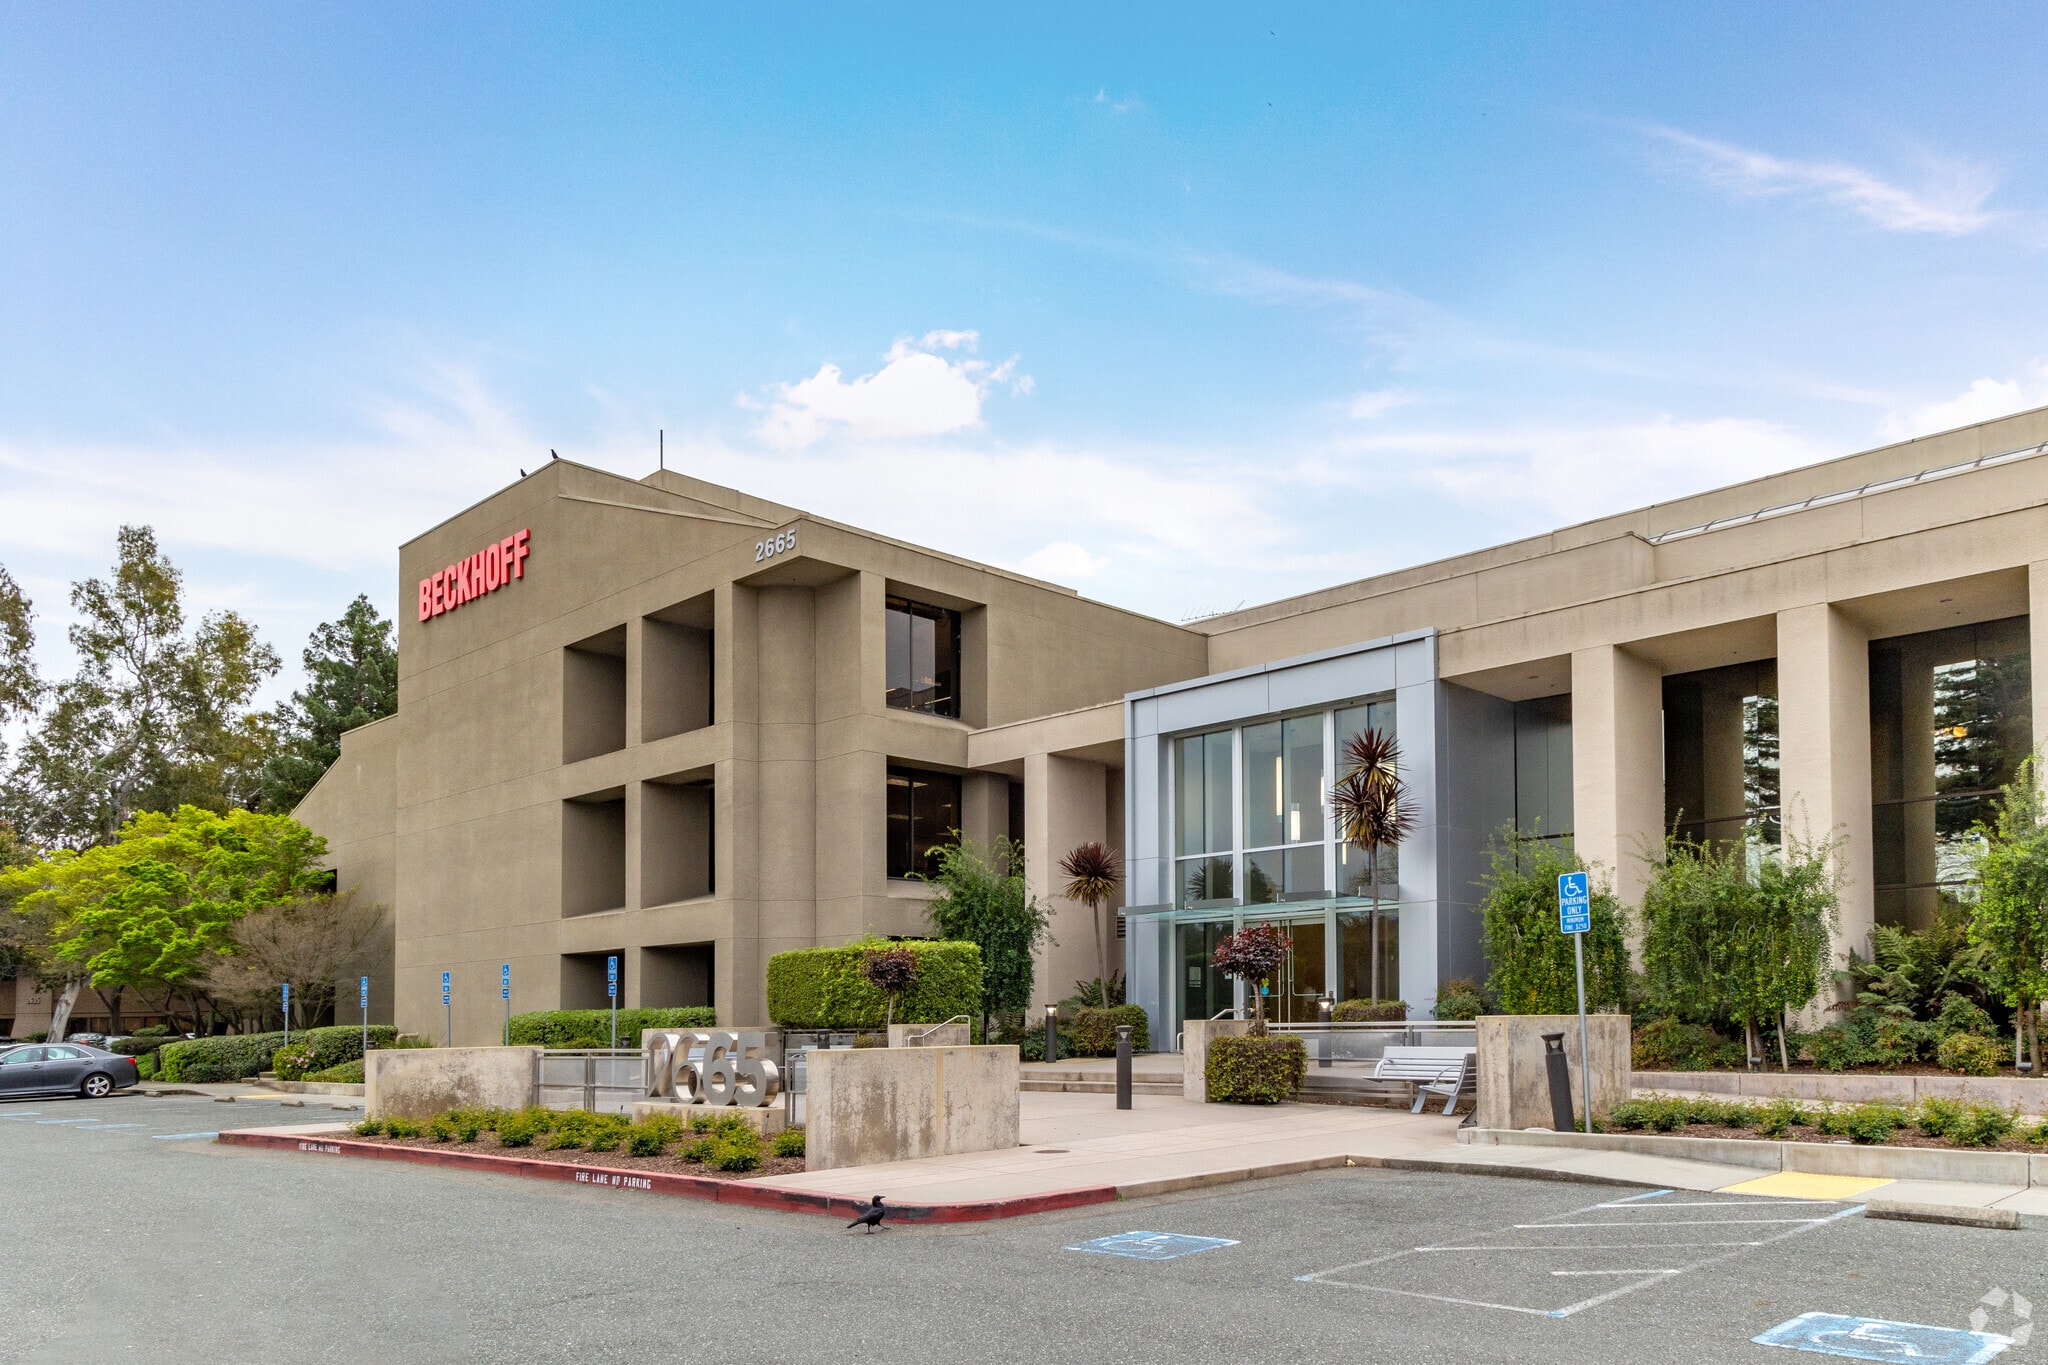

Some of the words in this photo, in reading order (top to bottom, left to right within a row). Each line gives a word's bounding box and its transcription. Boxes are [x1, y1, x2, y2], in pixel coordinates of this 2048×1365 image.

[755, 529, 796, 562] 2665
[419, 528, 530, 622] BECKHOFF
[1562, 896, 1587, 906] PARKING
[1567, 906, 1582, 914] ONLY
[647, 1031, 779, 1107] 2665
[324, 1144, 341, 1154] PARKING
[576, 1171, 589, 1182] FIRE
[592, 1173, 608, 1184] LANE
[612, 1175, 620, 1186] NO
[623, 1176, 651, 1189] PARKING
